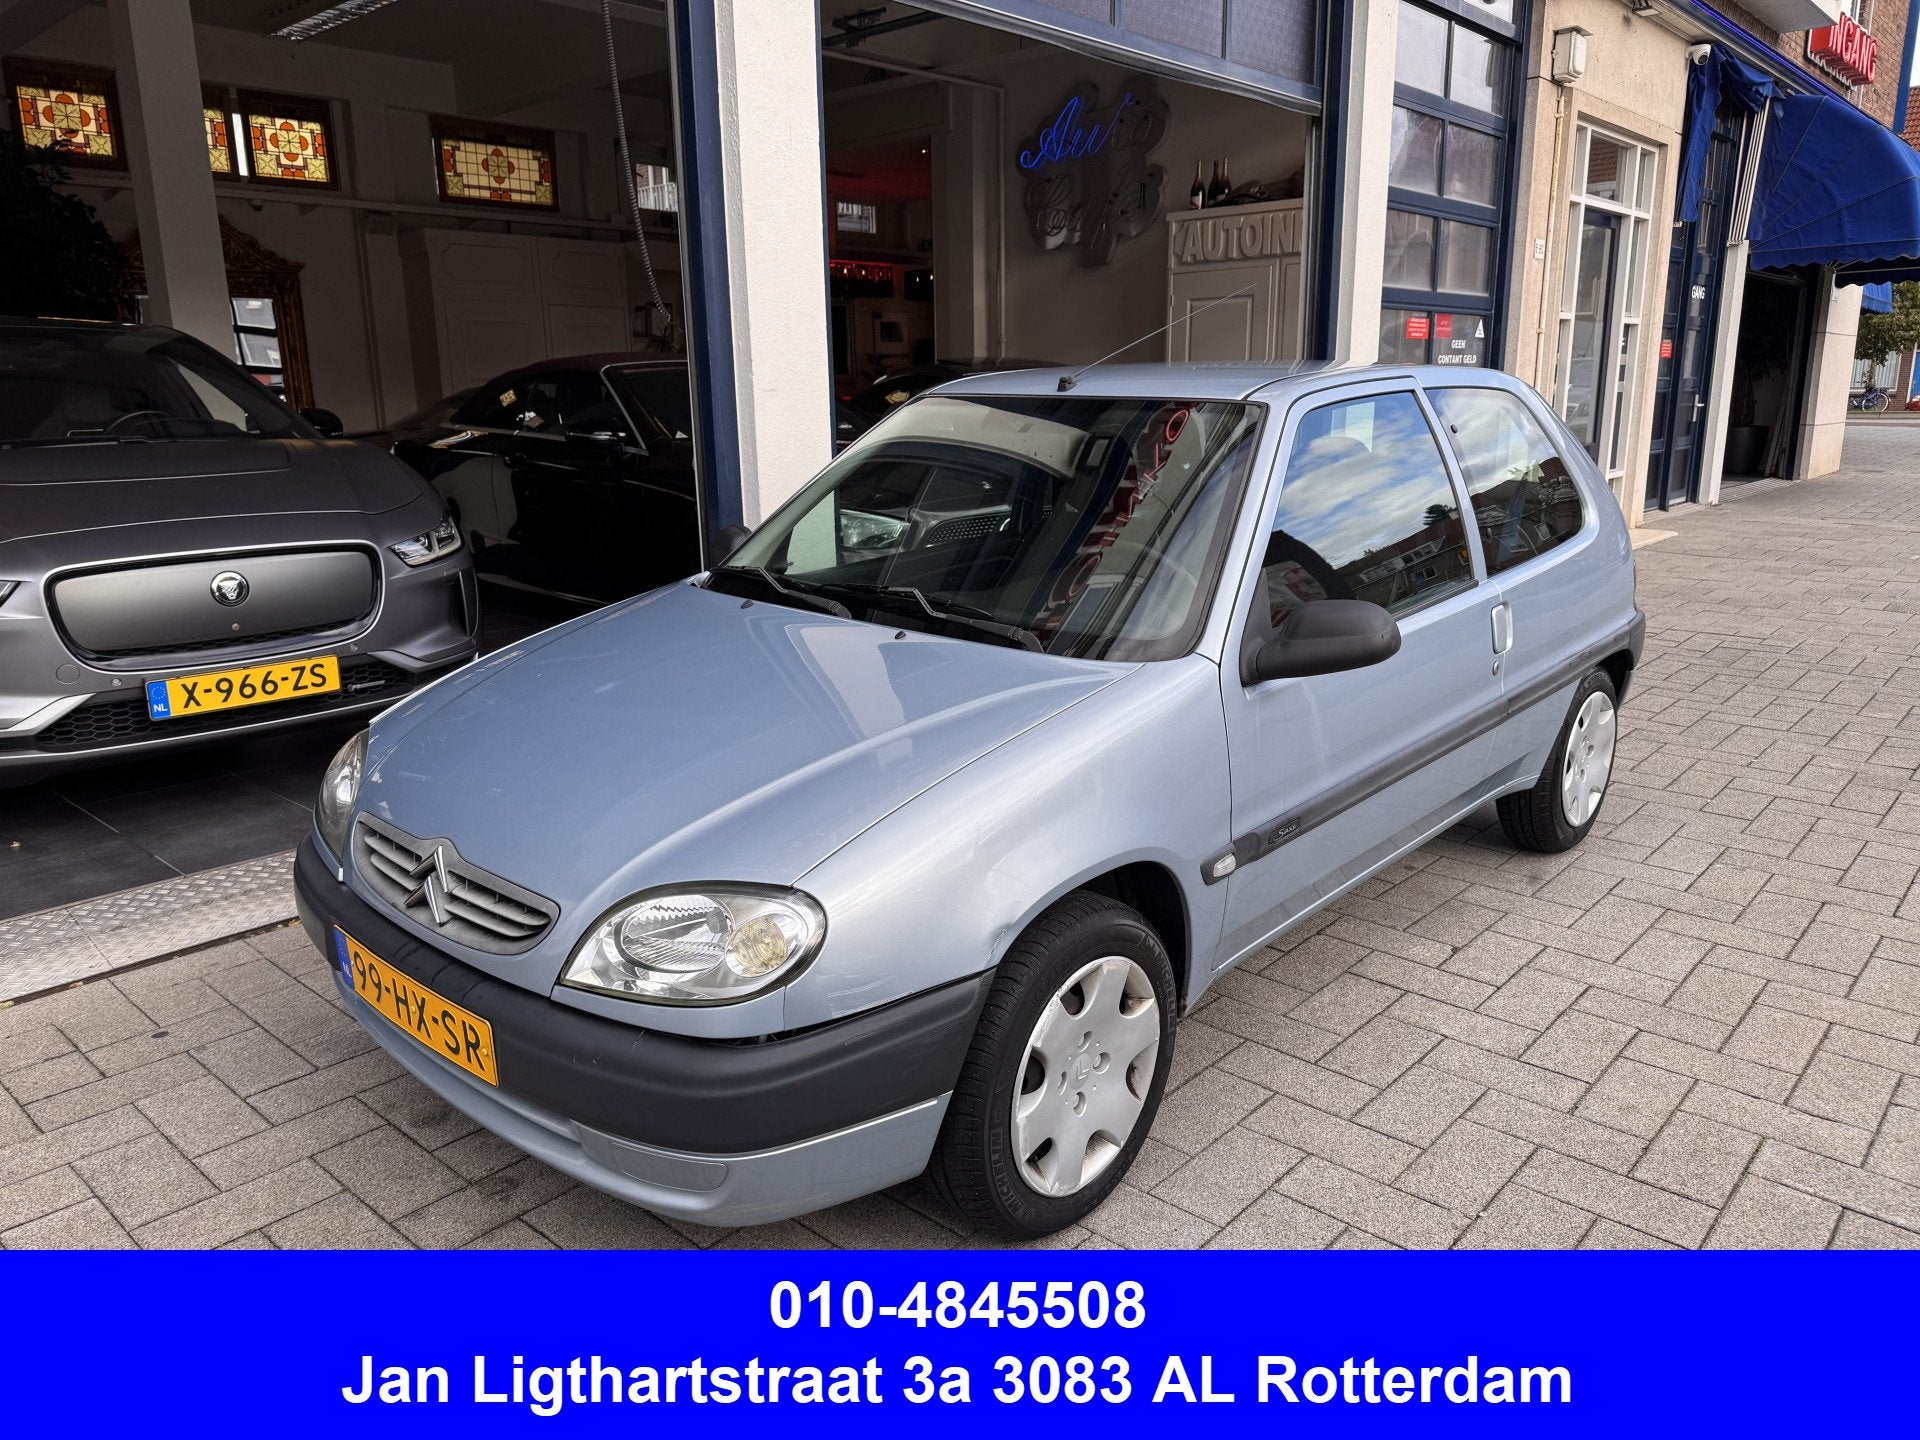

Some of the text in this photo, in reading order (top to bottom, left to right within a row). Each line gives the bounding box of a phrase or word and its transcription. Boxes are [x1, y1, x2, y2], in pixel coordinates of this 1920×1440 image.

[1019, 91, 1153, 170] Auto
[1181, 211, 1304, 262] AUTOIN
[1691, 285, 1706, 300] GANG
[1437, 354, 1477, 364] CONTANT GELD
[1451, 339, 1466, 349] GEEN
[181, 663, 327, 709] X-966-ZS
[153, 703, 168, 713] NL
[353, 950, 486, 1072] 99-HX-SR
